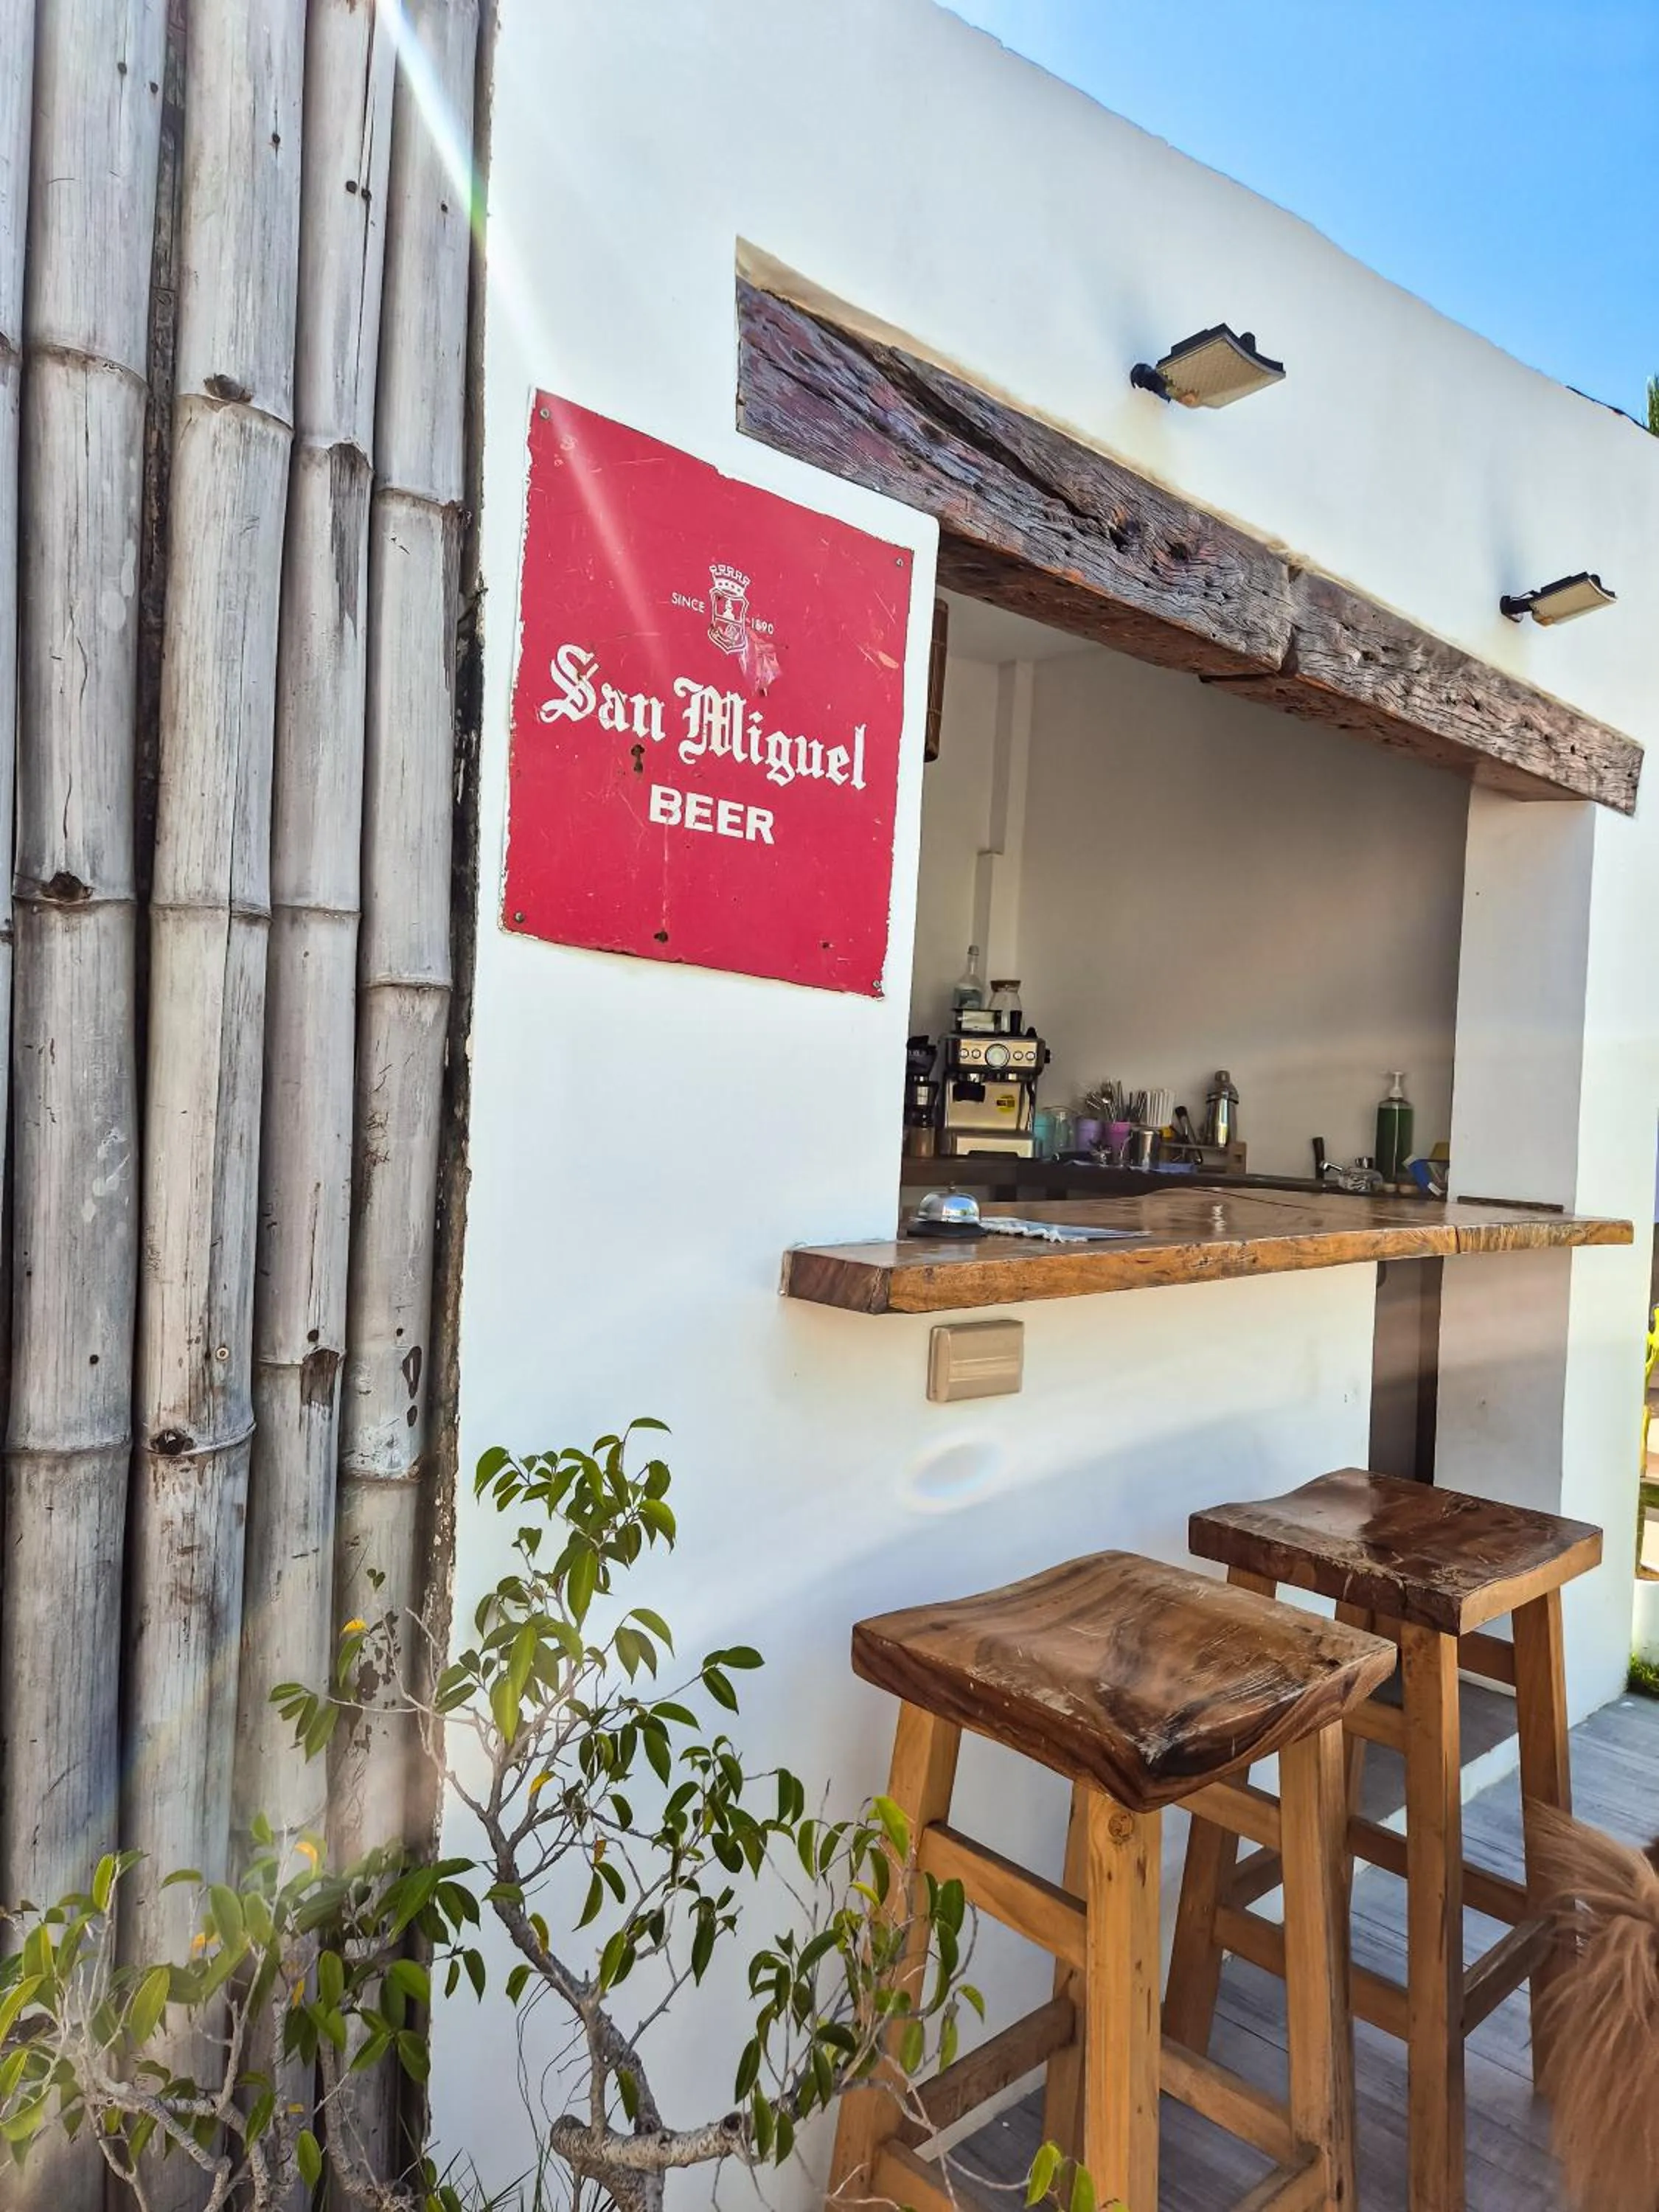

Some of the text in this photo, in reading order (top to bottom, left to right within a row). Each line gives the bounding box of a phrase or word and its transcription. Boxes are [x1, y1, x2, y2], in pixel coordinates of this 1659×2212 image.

[671, 592, 774, 635] SINCE 1890
[540, 644, 866, 790] San Miguel
[649, 784, 774, 844] BEER
